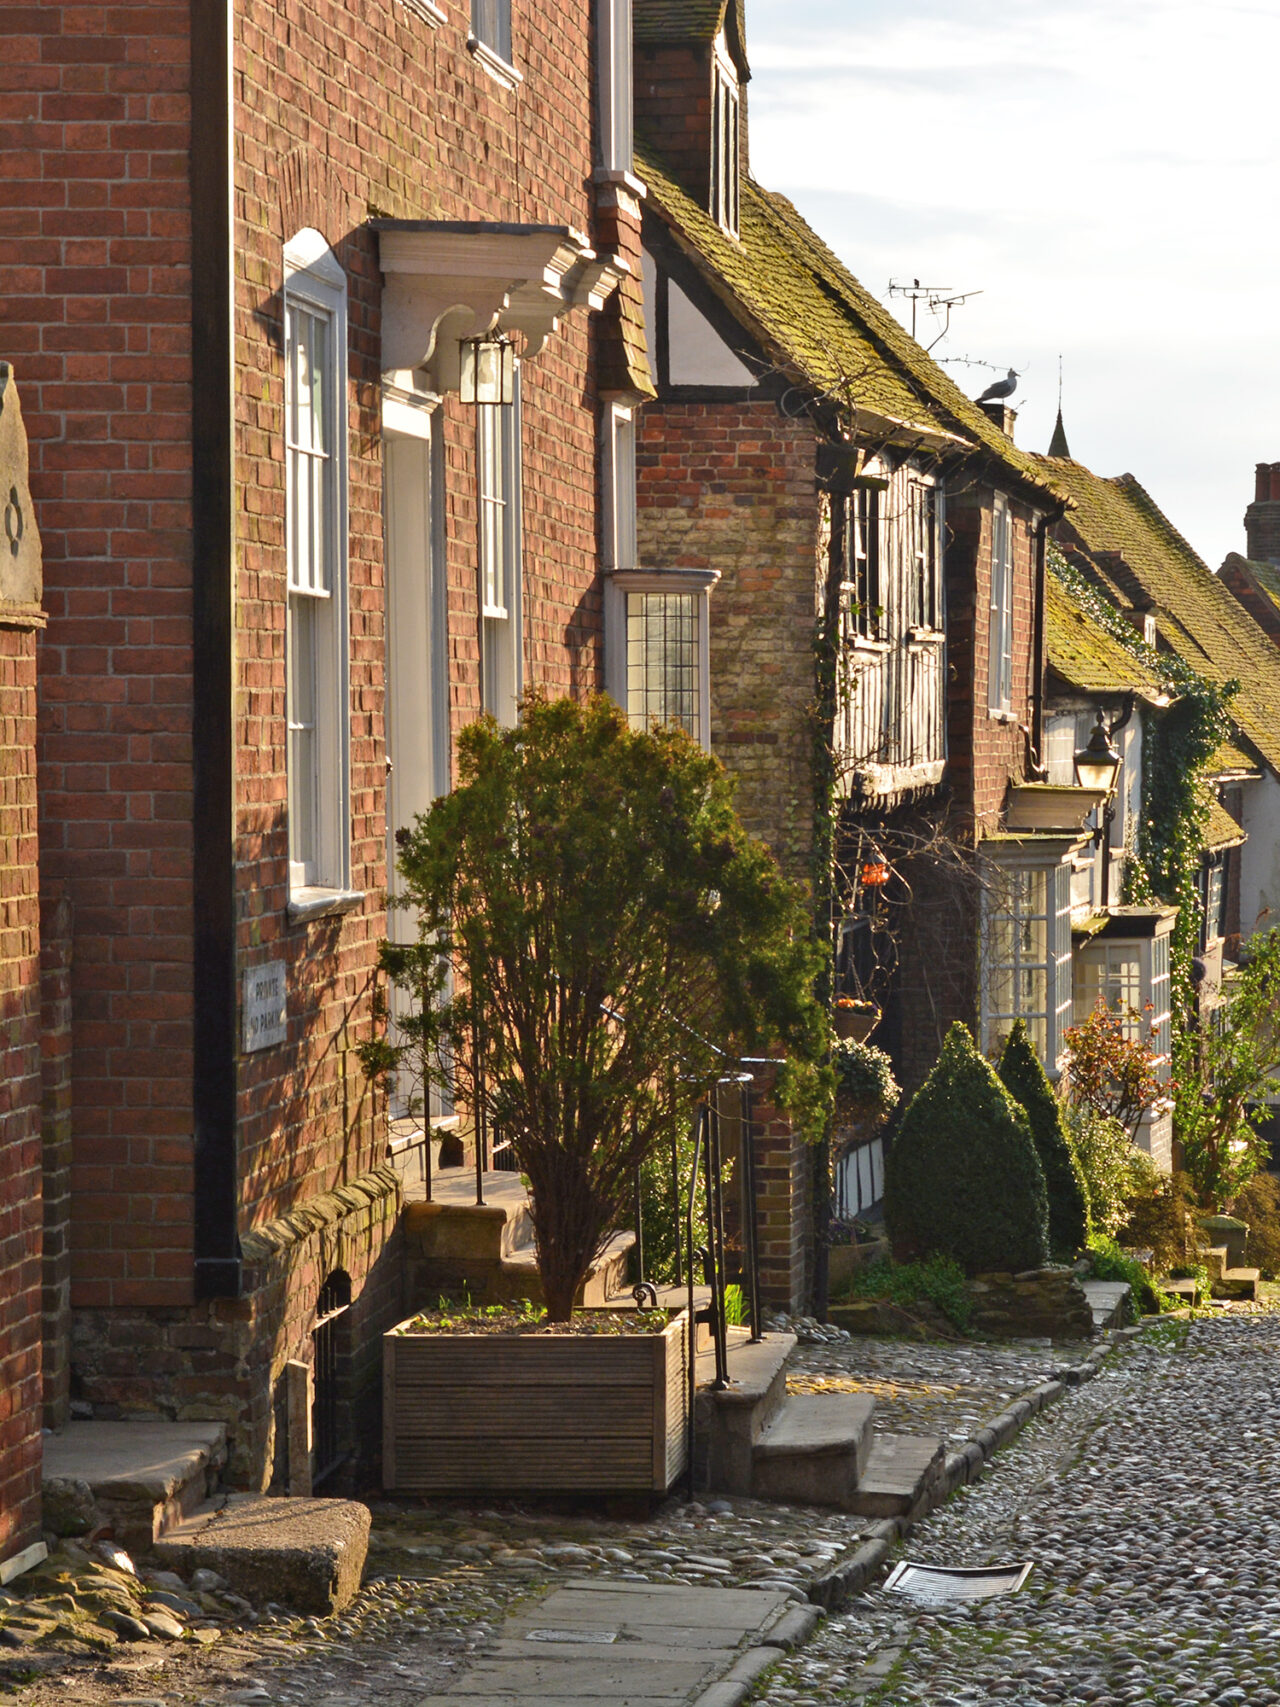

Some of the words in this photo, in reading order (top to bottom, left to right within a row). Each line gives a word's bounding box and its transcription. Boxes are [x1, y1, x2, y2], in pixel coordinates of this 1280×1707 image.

[256, 978, 279, 1002] PRIVATE
[251, 1016, 259, 1035] NO
[260, 1008, 283, 1033] PARKIN
